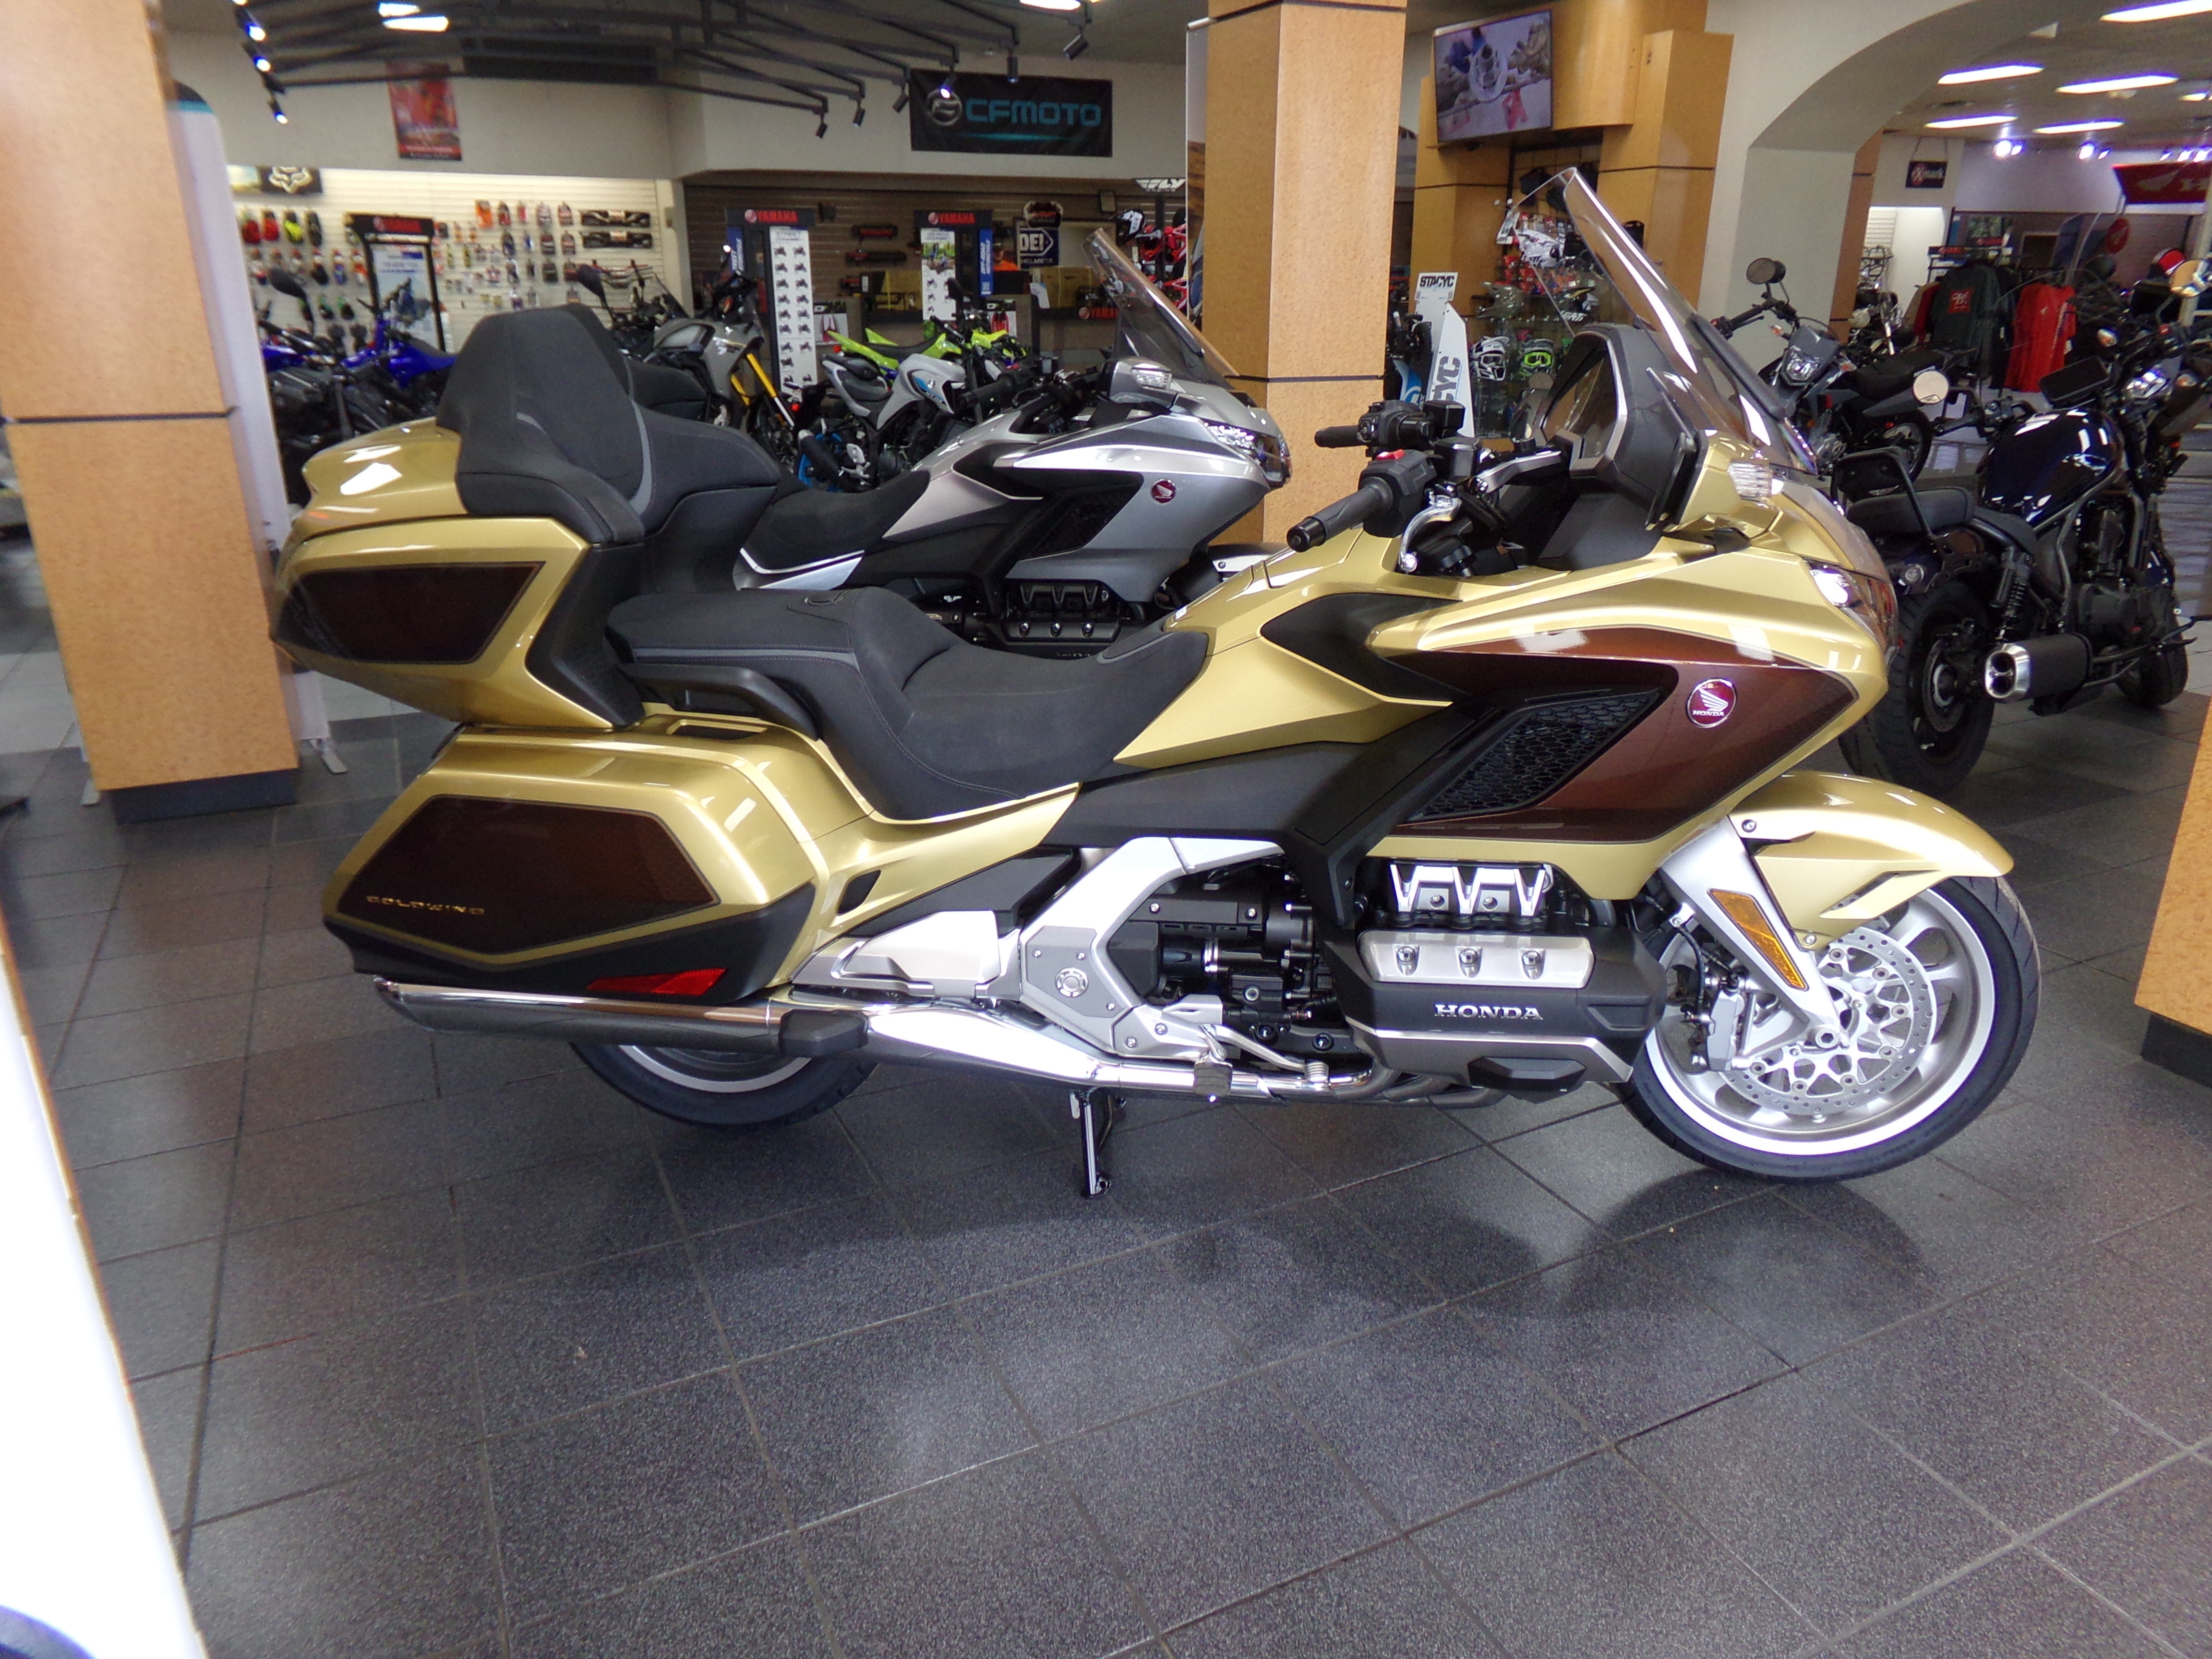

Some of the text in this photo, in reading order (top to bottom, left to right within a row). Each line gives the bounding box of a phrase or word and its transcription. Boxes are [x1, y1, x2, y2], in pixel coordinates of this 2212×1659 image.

[965, 98, 1102, 127] CFMOTO
[756, 210, 798, 222] YAMAHA
[939, 212, 975, 224] YAMAHA
[1419, 276, 1455, 288] STACYC
[1434, 1004, 1544, 1021] HONDA
